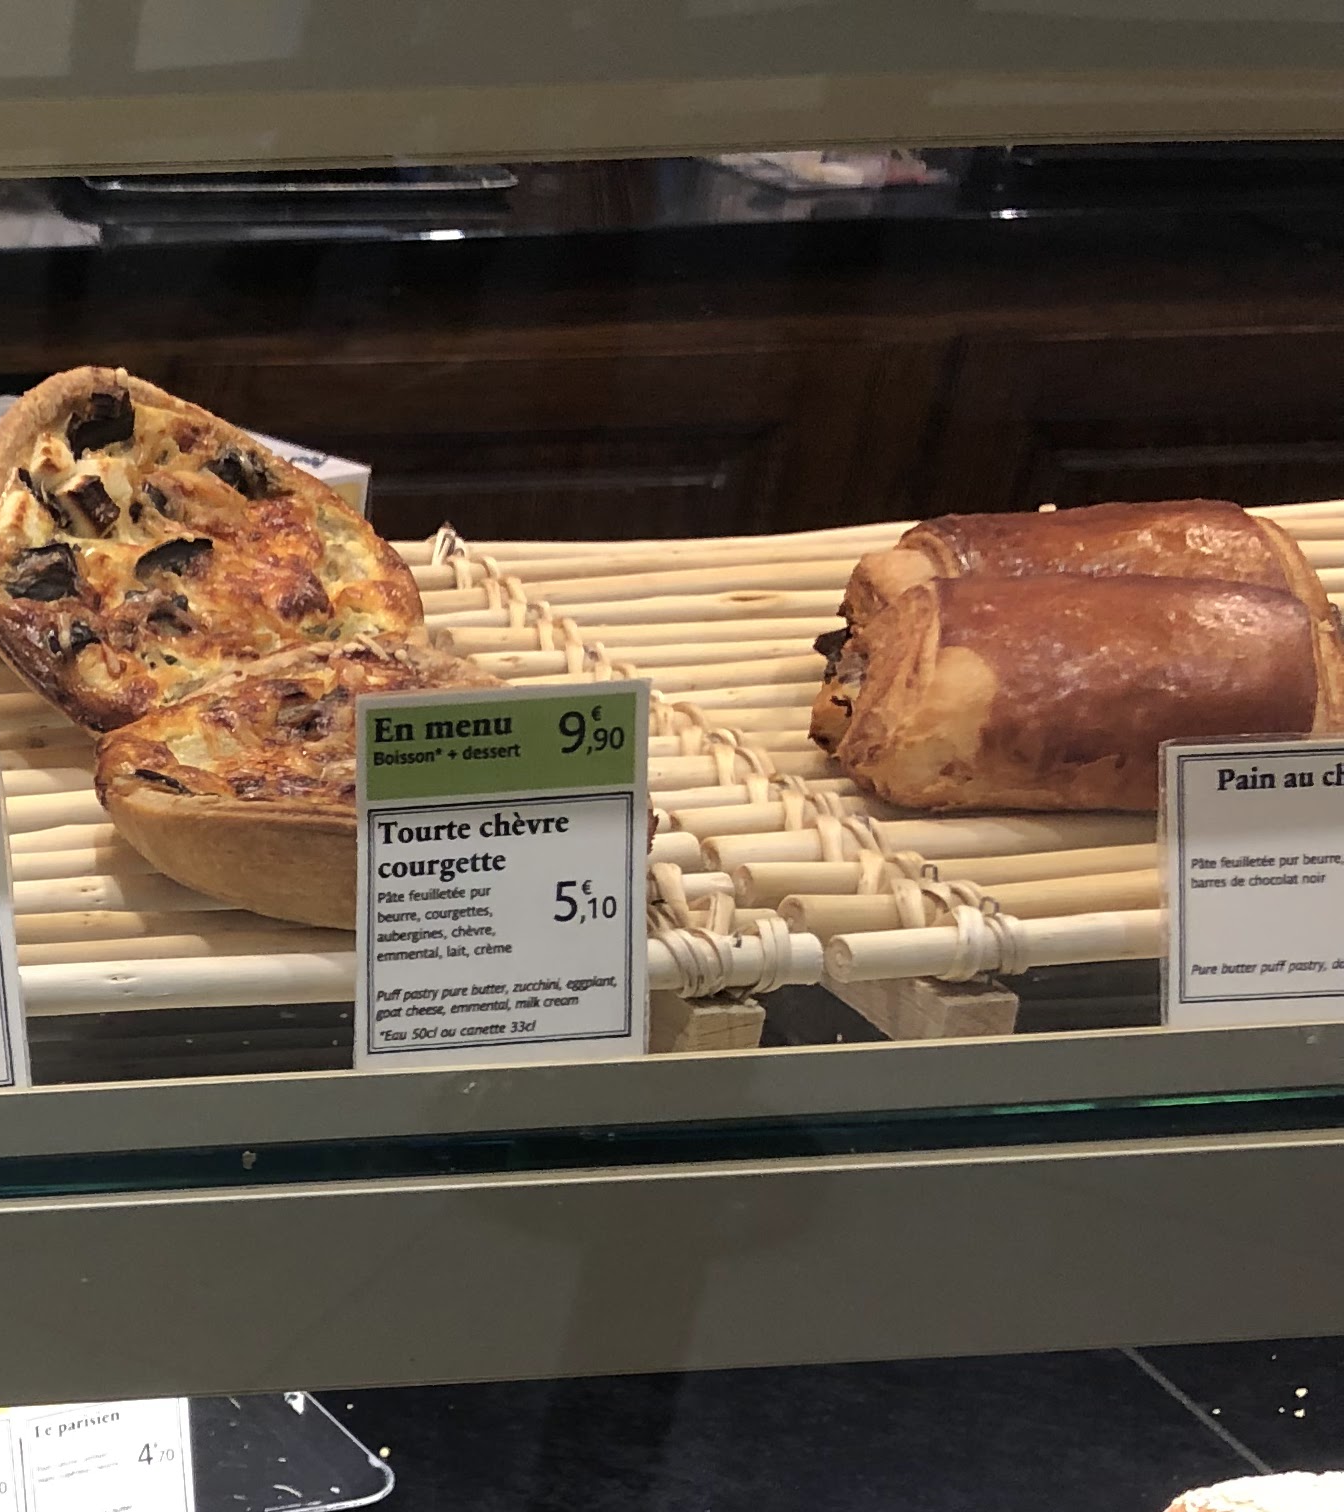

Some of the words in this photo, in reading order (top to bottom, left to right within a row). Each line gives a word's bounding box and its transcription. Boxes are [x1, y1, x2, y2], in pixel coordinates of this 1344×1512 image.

[374, 717, 414, 743] En
[425, 715, 513, 740] menu
[447, 750, 456, 760] +
[463, 744, 521, 760] dessert
[1217, 767, 1276, 790] Pain
[1284, 772, 1314, 788] au
[378, 821, 471, 844] Tourte
[479, 812, 569, 838] chèvre
[378, 852, 506, 882] courgette
[1191, 877, 1227, 888] barres
[1231, 876, 1246, 887] de
[1249, 874, 1298, 887] chocolat
[1302, 872, 1325, 885] noir
[378, 891, 404, 903] Pâte
[409, 887, 465, 901] feuilletée
[470, 887, 491, 900] pur
[377, 910, 420, 924] beurre,
[425, 906, 493, 922] courgettes,
[377, 929, 447, 944] aubergines,
[451, 924, 496, 938] chèvre,
[377, 947, 442, 962] emmental,
[447, 944, 470, 958] lait,
[474, 942, 512, 955] crème
[59, 1411, 120, 1437] parisien
